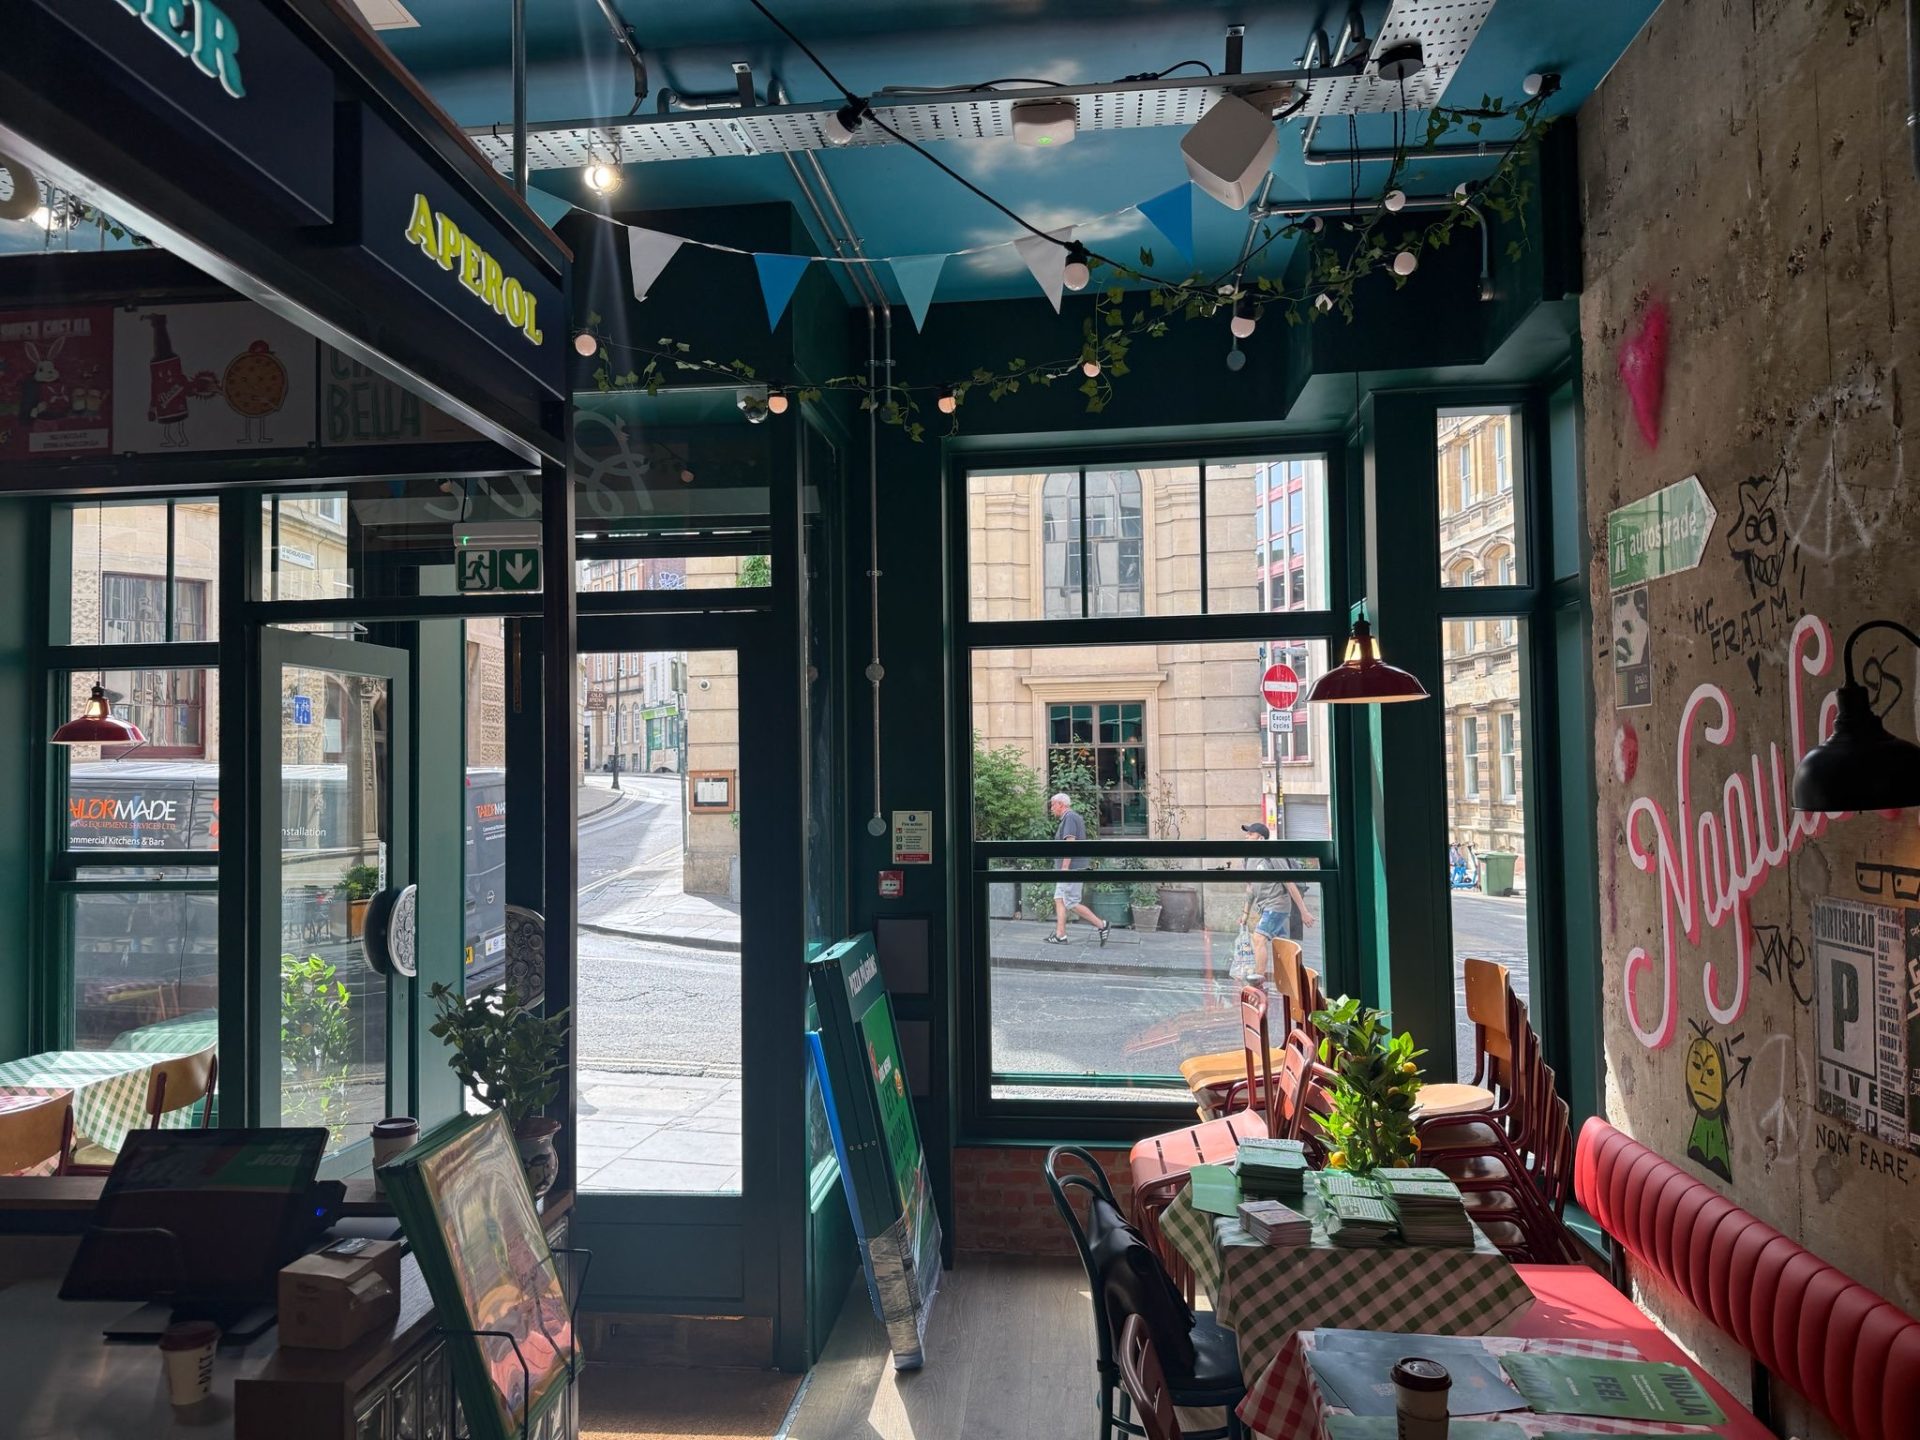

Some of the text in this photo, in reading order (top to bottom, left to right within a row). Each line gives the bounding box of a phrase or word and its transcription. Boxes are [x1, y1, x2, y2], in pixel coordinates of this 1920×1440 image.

[405, 193, 544, 346] APEROL
[1630, 505, 1696, 557] autostrade
[1272, 713, 1291, 722] Except
[1272, 722, 1290, 730] cycles
[108, 837, 141, 846] Kitchens
[141, 838, 148, 846] &
[149, 838, 165, 847] Bars
[1815, 905, 1875, 948] PORTISHEAD
[848, 968, 863, 998] PIZZA
[1831, 959, 1859, 1053] P
[1819, 1062, 1878, 1107] LIVE
[1816, 1124, 1909, 1186] NON FARE
[1590, 1375, 1630, 1402] FEEL
